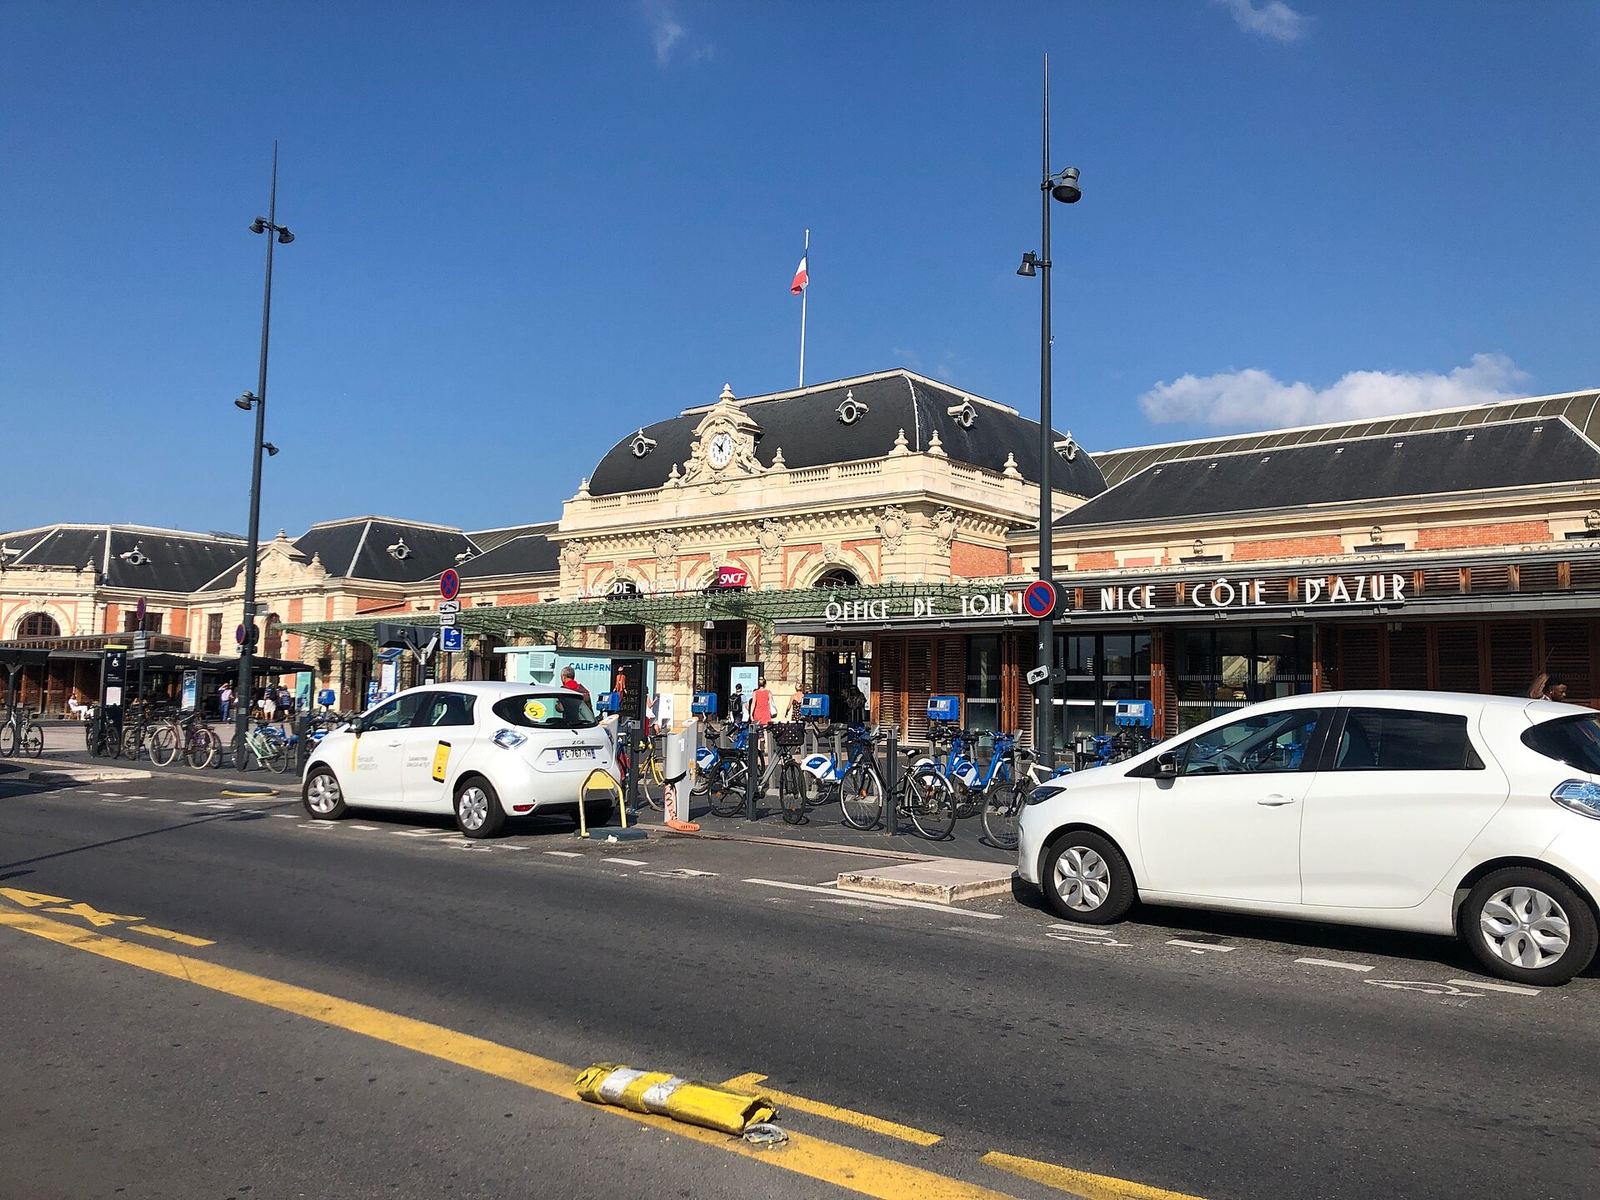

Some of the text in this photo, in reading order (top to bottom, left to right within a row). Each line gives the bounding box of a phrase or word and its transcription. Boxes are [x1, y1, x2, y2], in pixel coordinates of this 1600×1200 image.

[720, 572, 746, 585] SNCF
[614, 582, 631, 594] DE
[825, 574, 1405, 622] OFFICE DE TOURI NICE CÔTE D'AZUR
